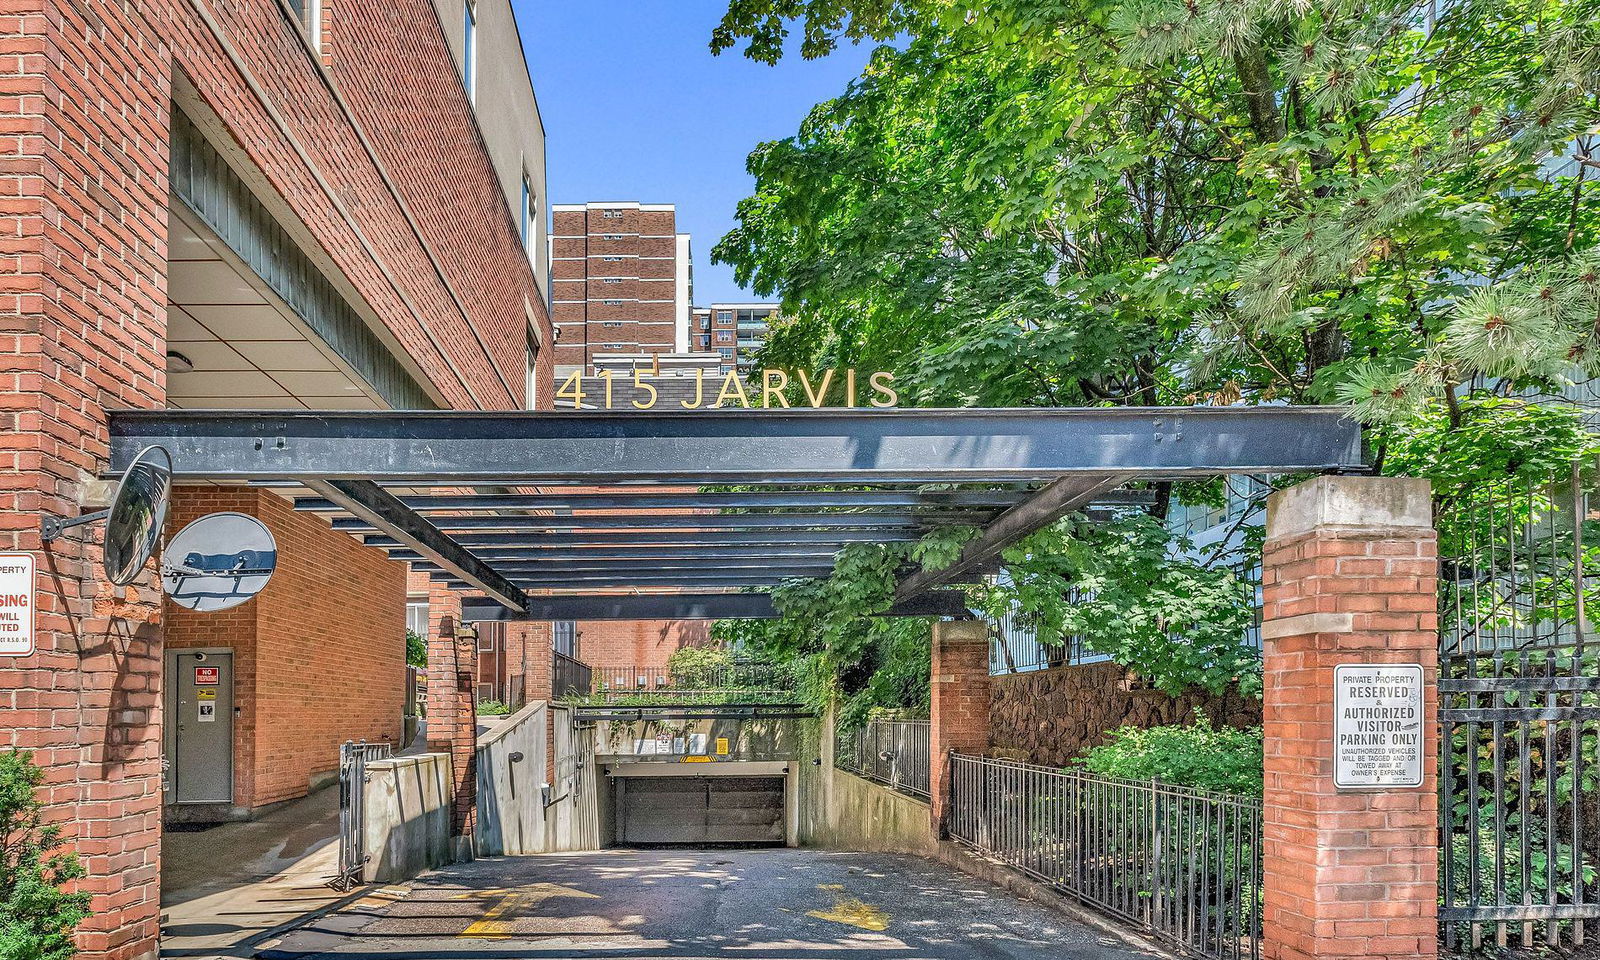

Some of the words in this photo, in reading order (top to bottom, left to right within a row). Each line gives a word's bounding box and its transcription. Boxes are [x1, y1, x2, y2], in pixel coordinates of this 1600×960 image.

[556, 368, 658, 409] 415
[680, 367, 898, 409] JARVIS
[0, 624, 19, 632] TED
[1350, 687, 1408, 698] RESERVED
[1344, 708, 1415, 719] AUTHORIZED
[1357, 721, 1402, 732] VISITOR
[1341, 734, 1386, 745] PARKING
[1392, 734, 1417, 745] ONLY
